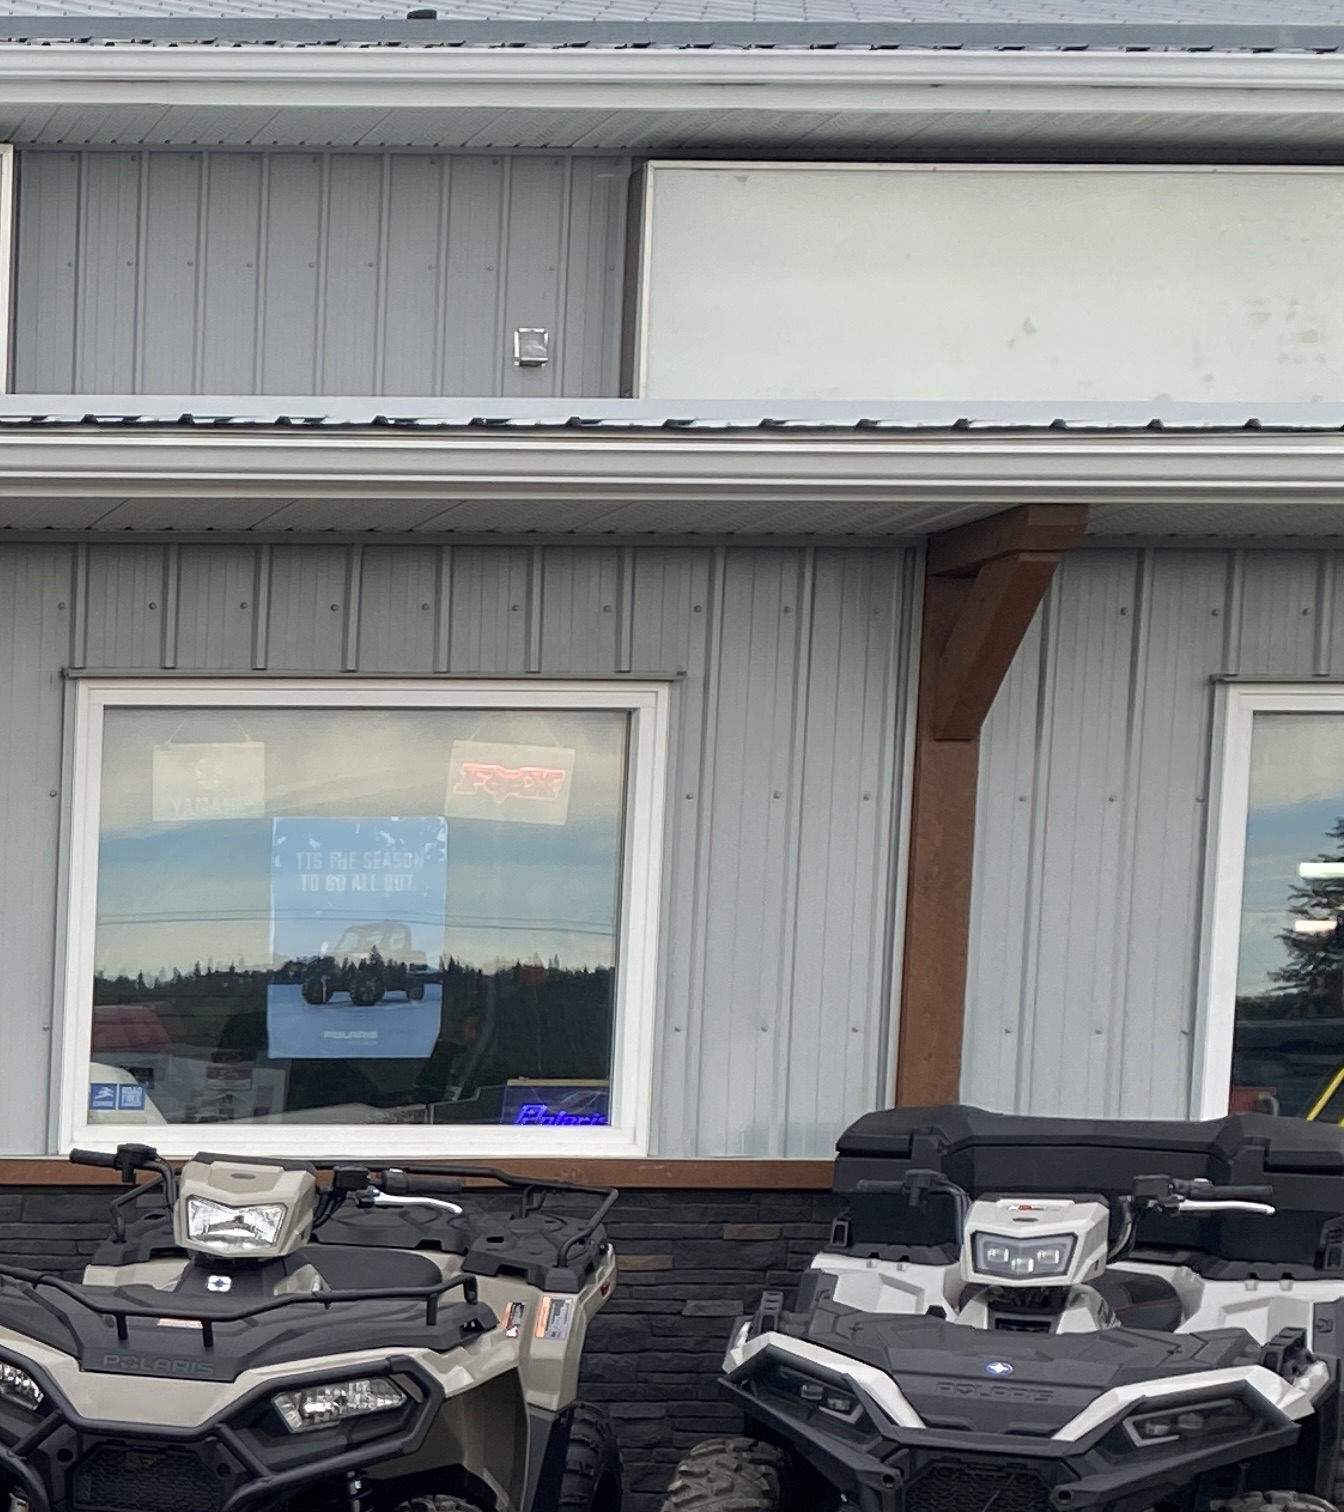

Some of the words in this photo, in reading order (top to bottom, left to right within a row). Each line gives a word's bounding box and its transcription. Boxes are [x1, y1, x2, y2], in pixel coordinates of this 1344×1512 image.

[330, 852, 357, 870] THE
[363, 851, 424, 870] SEASON
[300, 874, 319, 891] TO
[323, 1031, 378, 1039] POLARIS
[103, 1354, 214, 1375] POLARIS
[936, 1381, 1055, 1402] POLARIS
